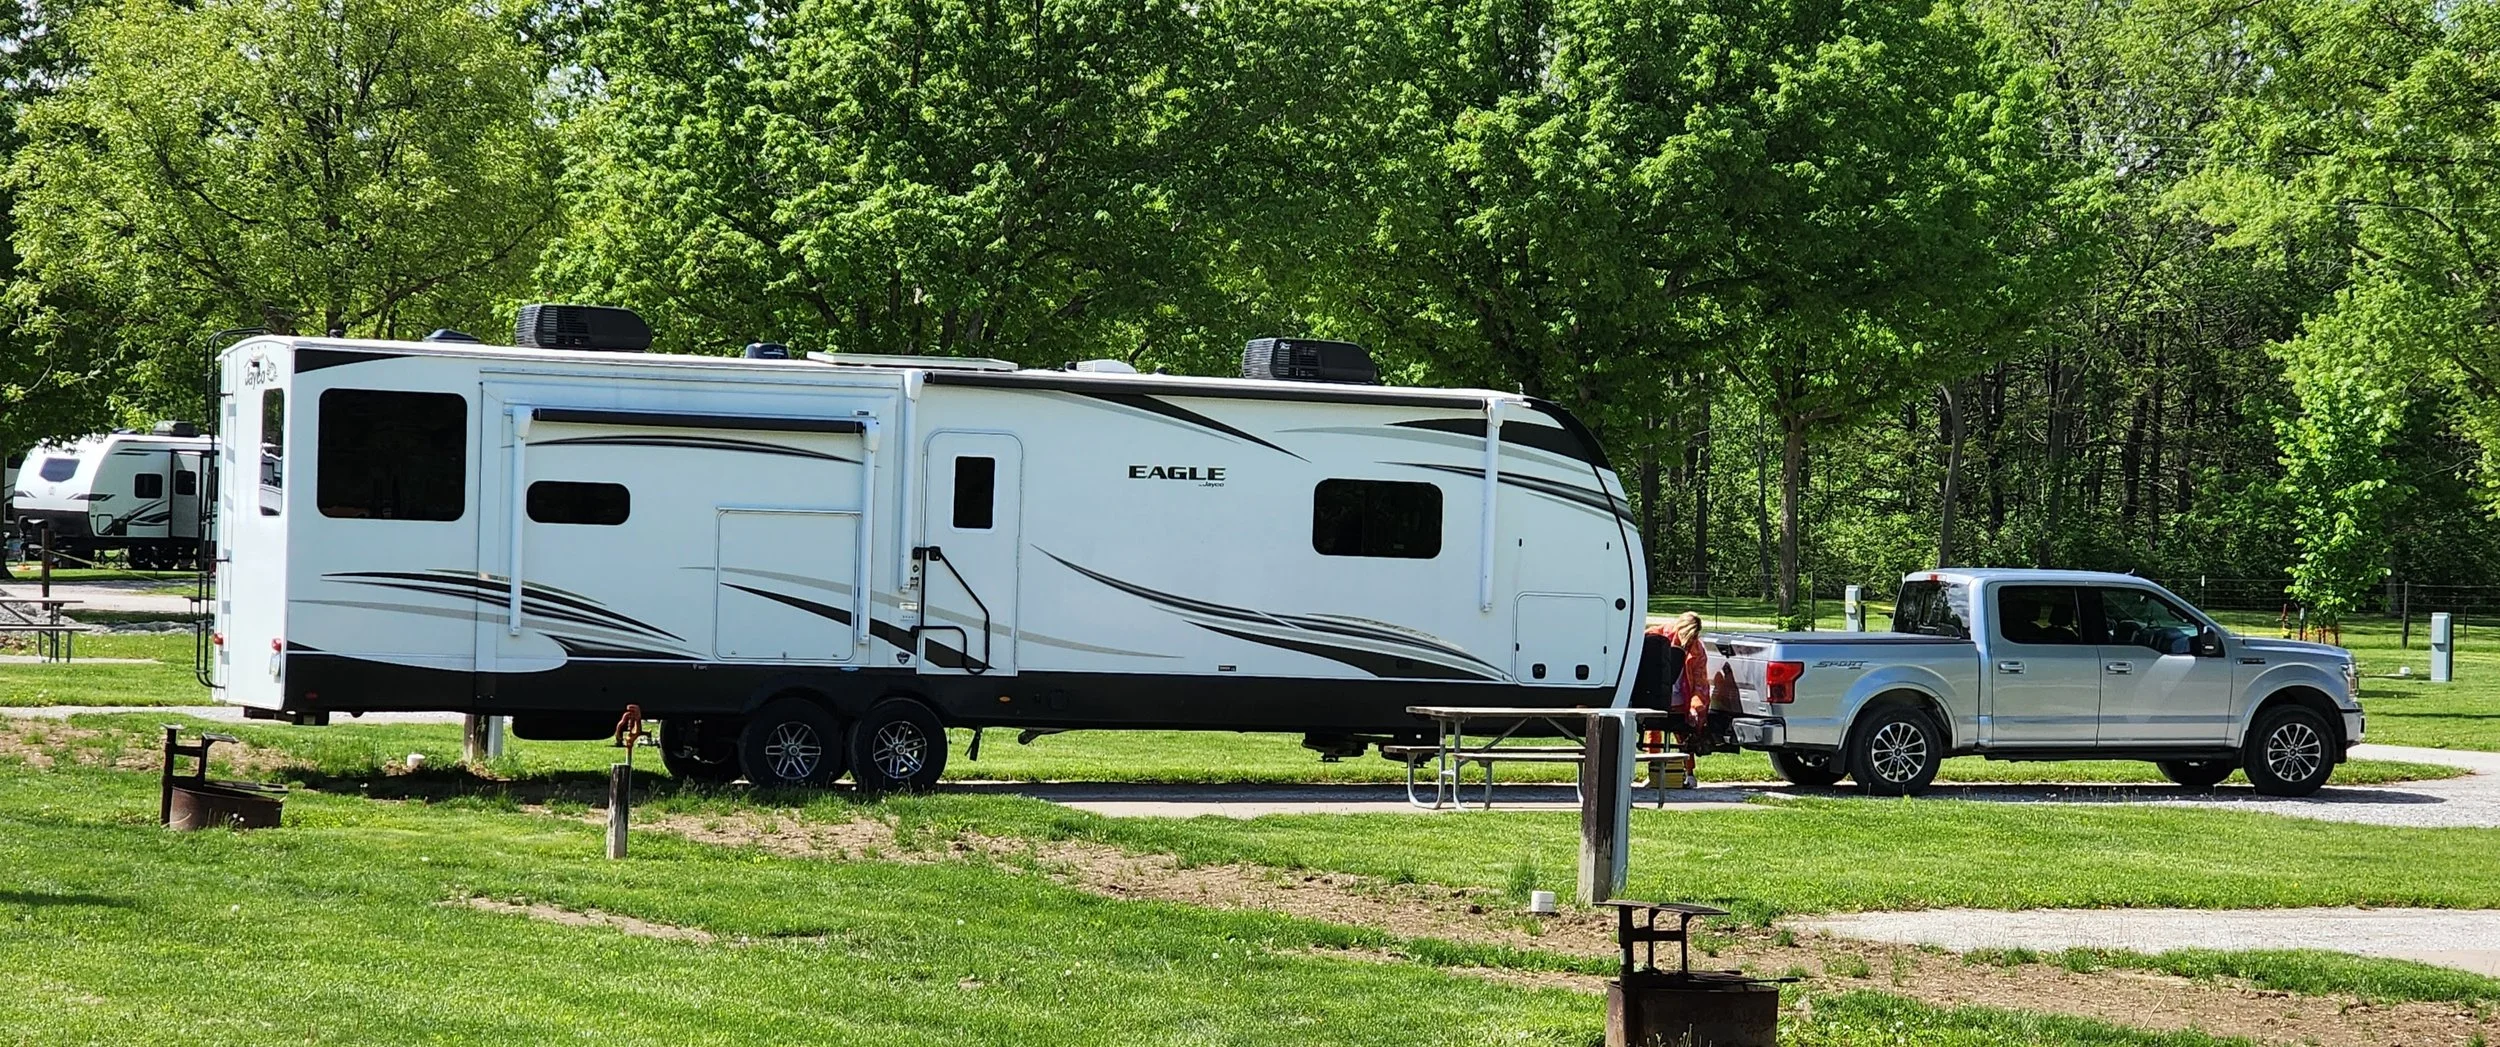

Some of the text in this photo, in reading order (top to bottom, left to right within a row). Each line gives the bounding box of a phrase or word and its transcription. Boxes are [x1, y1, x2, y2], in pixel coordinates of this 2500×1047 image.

[245, 367, 265, 390] Jayco
[1128, 465, 1226, 481] EAGLE
[1812, 660, 1869, 668] SPORT
